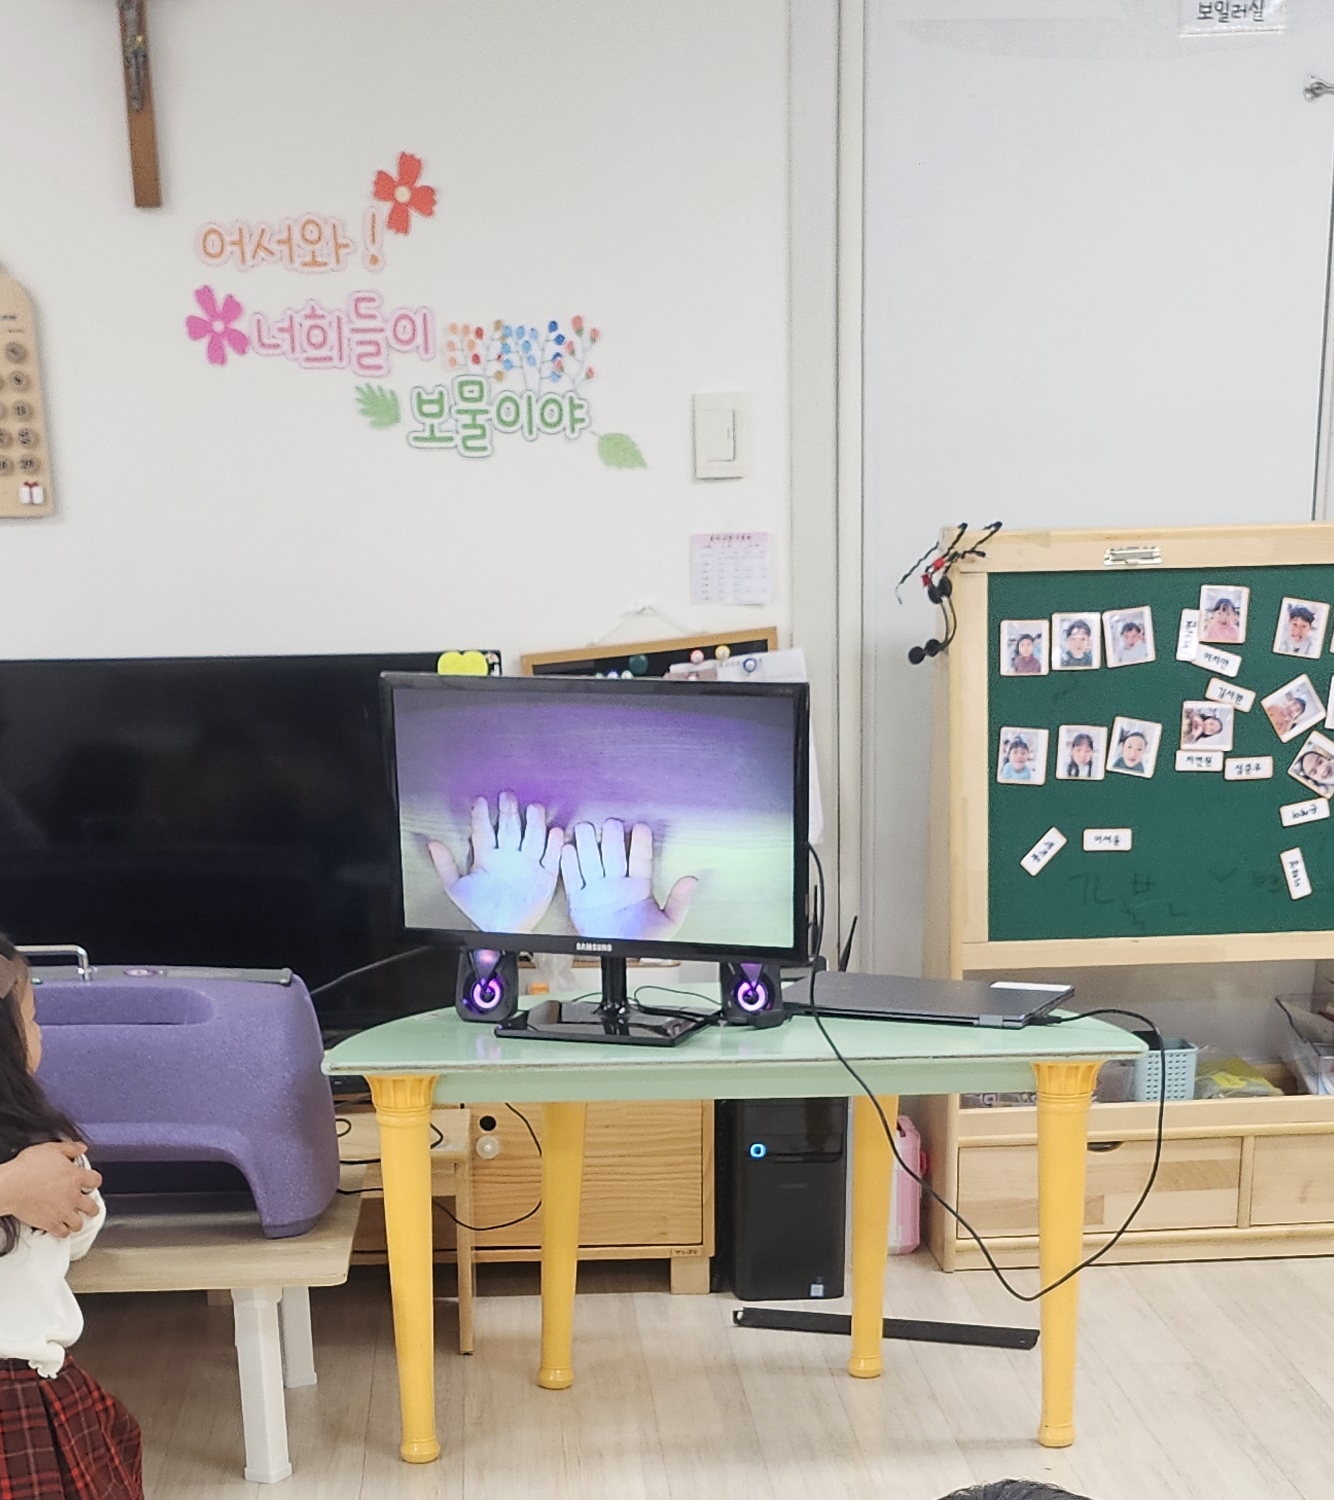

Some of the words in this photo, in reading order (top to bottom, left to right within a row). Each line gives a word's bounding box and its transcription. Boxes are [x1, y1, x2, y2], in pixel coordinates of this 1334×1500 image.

[1197, 0, 1265, 23] 보일러실
[255, 296, 430, 371] 너희들이
[411, 379, 587, 454] 보물이야
